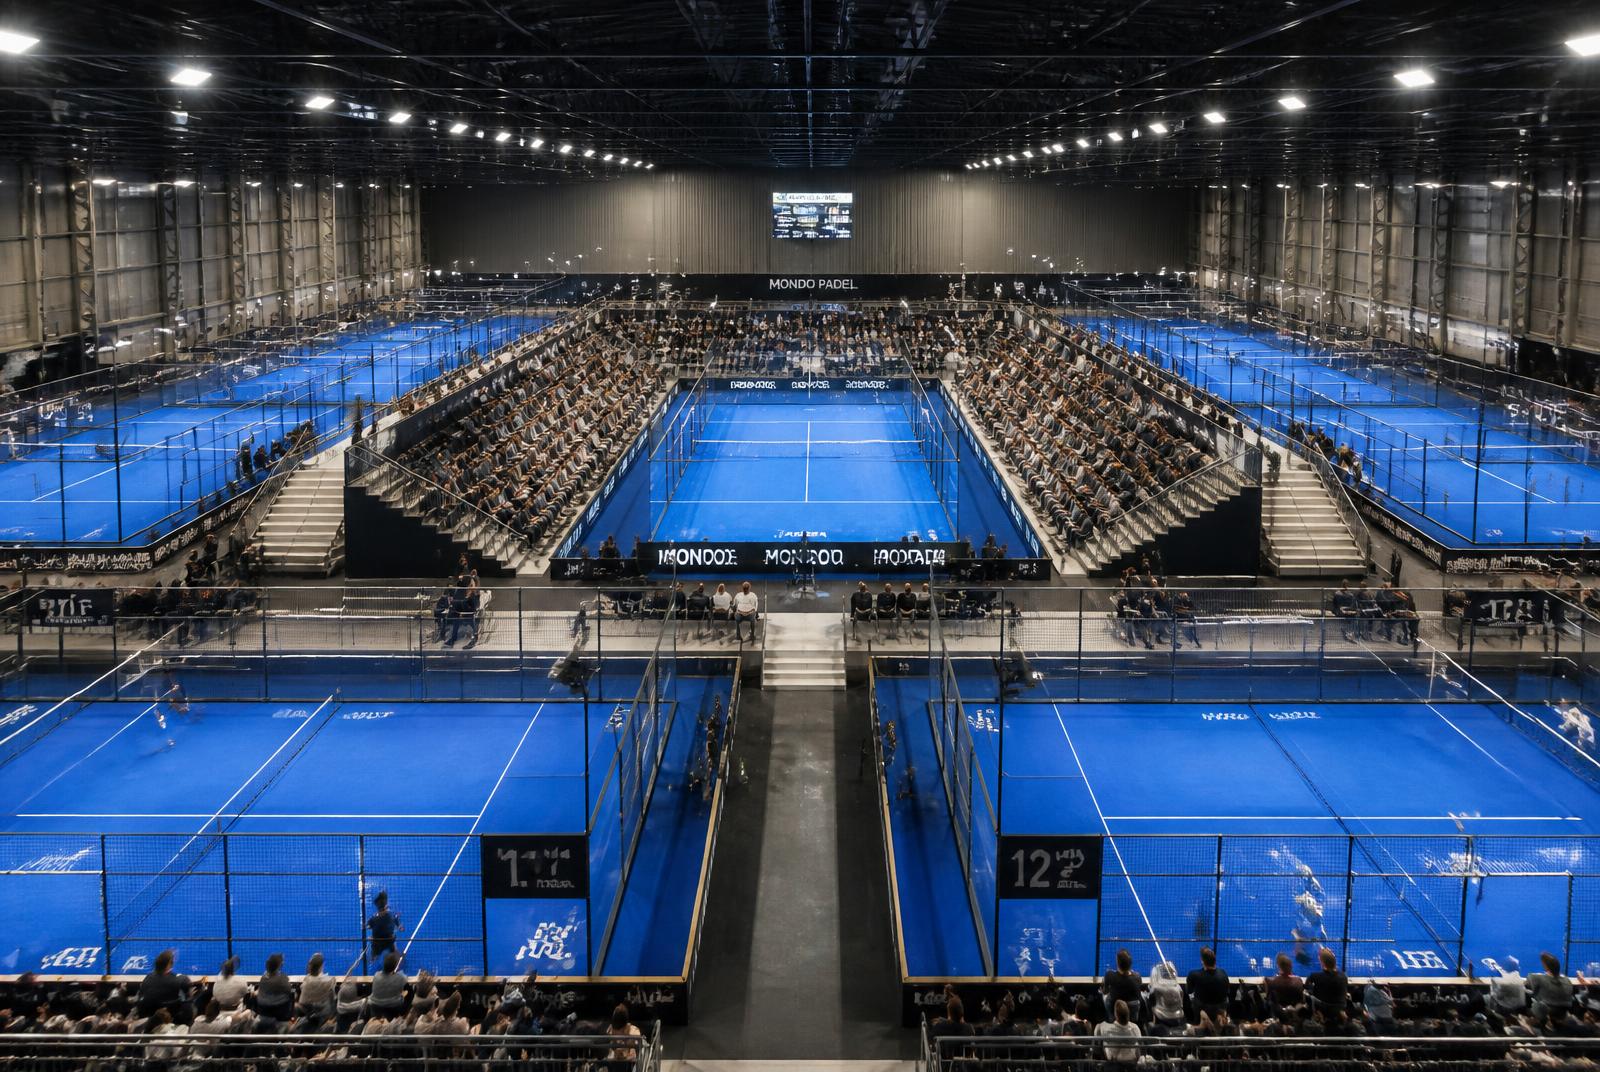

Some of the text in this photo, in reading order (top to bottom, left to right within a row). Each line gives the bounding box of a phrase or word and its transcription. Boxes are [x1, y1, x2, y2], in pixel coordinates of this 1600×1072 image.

[769, 278, 859, 290] MONDO PADEL
[1011, 849, 1051, 888] 12
